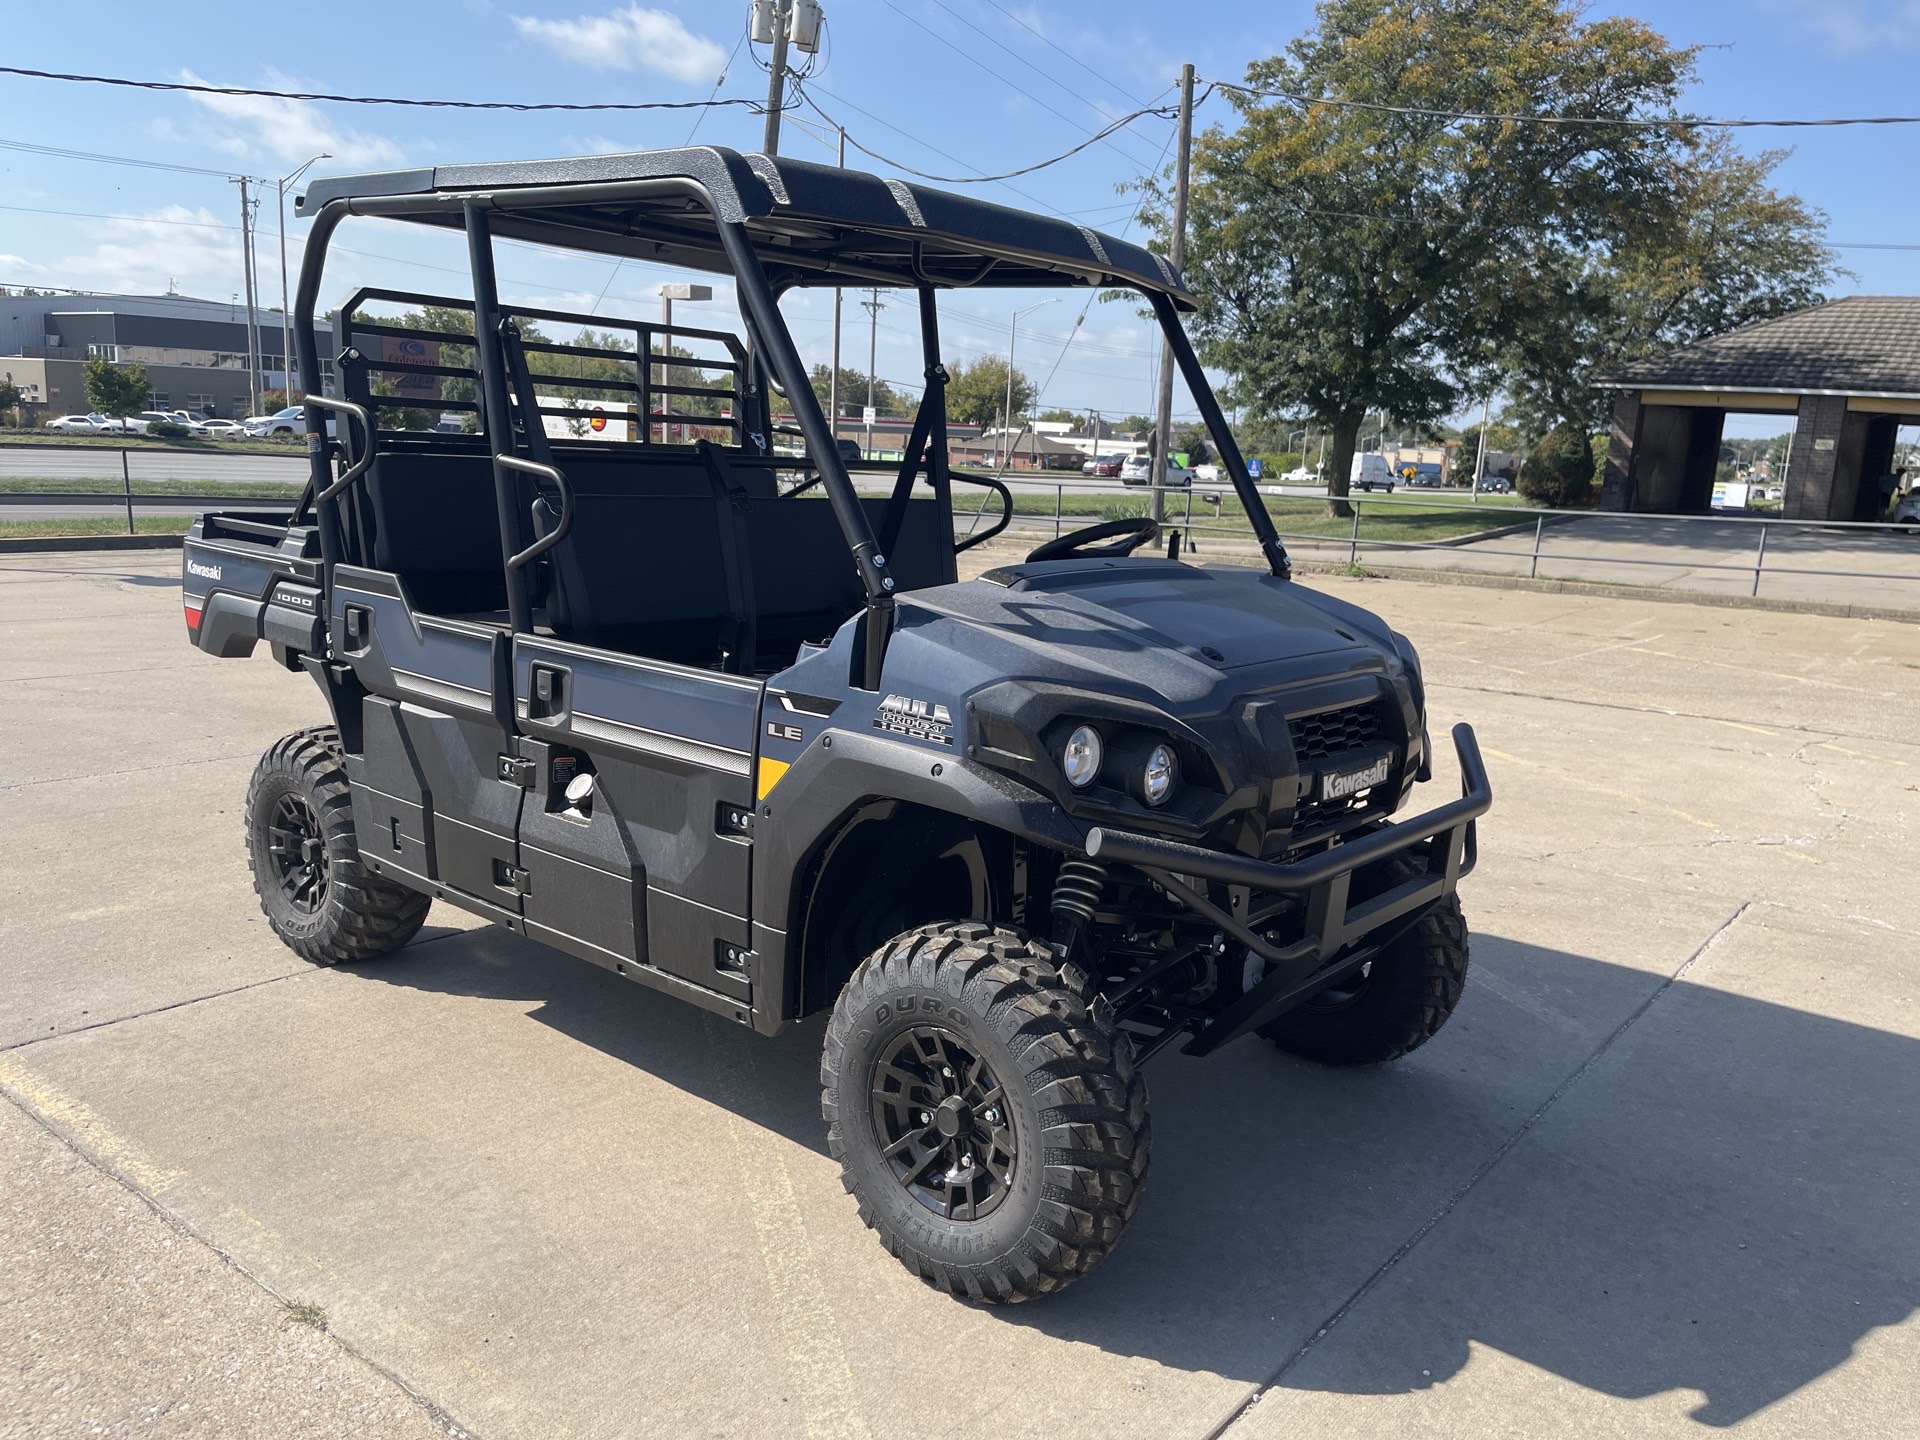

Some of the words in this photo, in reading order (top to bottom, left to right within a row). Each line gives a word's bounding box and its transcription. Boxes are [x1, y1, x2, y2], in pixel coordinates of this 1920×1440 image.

[187, 559, 221, 580] Kawasaki
[277, 593, 312, 607] 1000
[876, 693, 953, 727] MULE
[767, 722, 802, 741] LE
[880, 721, 948, 744] 1000
[1323, 757, 1388, 800] Kawasaki
[874, 994, 970, 1029] DURO
